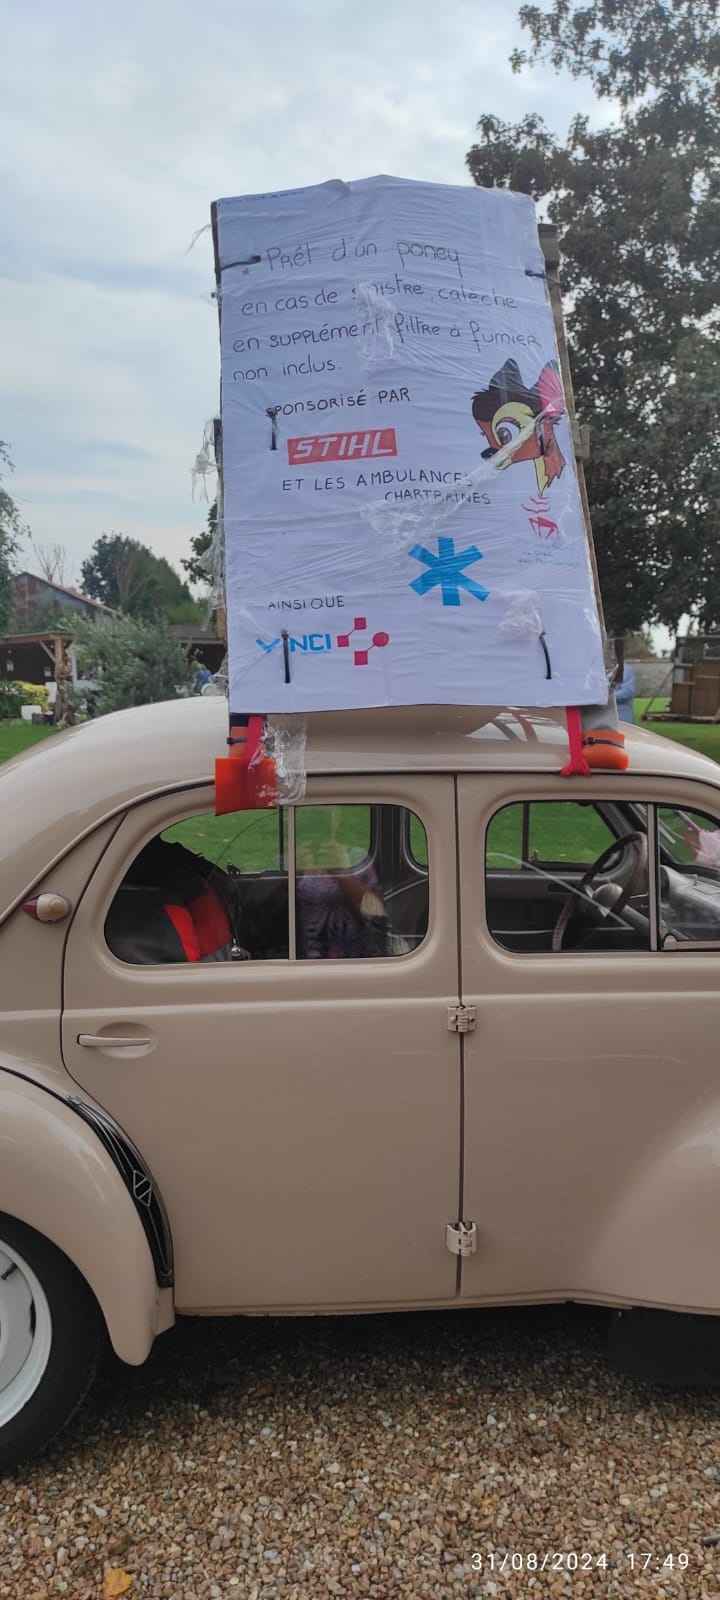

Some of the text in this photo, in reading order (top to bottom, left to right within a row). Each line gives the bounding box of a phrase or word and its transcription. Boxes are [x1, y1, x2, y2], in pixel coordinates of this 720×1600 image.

[396, 240, 463, 278] poney
[241, 301, 268, 316] en
[275, 296, 309, 311] cas
[315, 288, 338, 306] de
[232, 337, 260, 353] en
[233, 368, 268, 381] non
[378, 387, 411, 404] PAR
[293, 431, 392, 459] STIHL
[282, 479, 304, 491] ET
[314, 477, 345, 491] LES
[268, 595, 345, 610] AINSI QUE
[256, 633, 332, 654] VNCI
